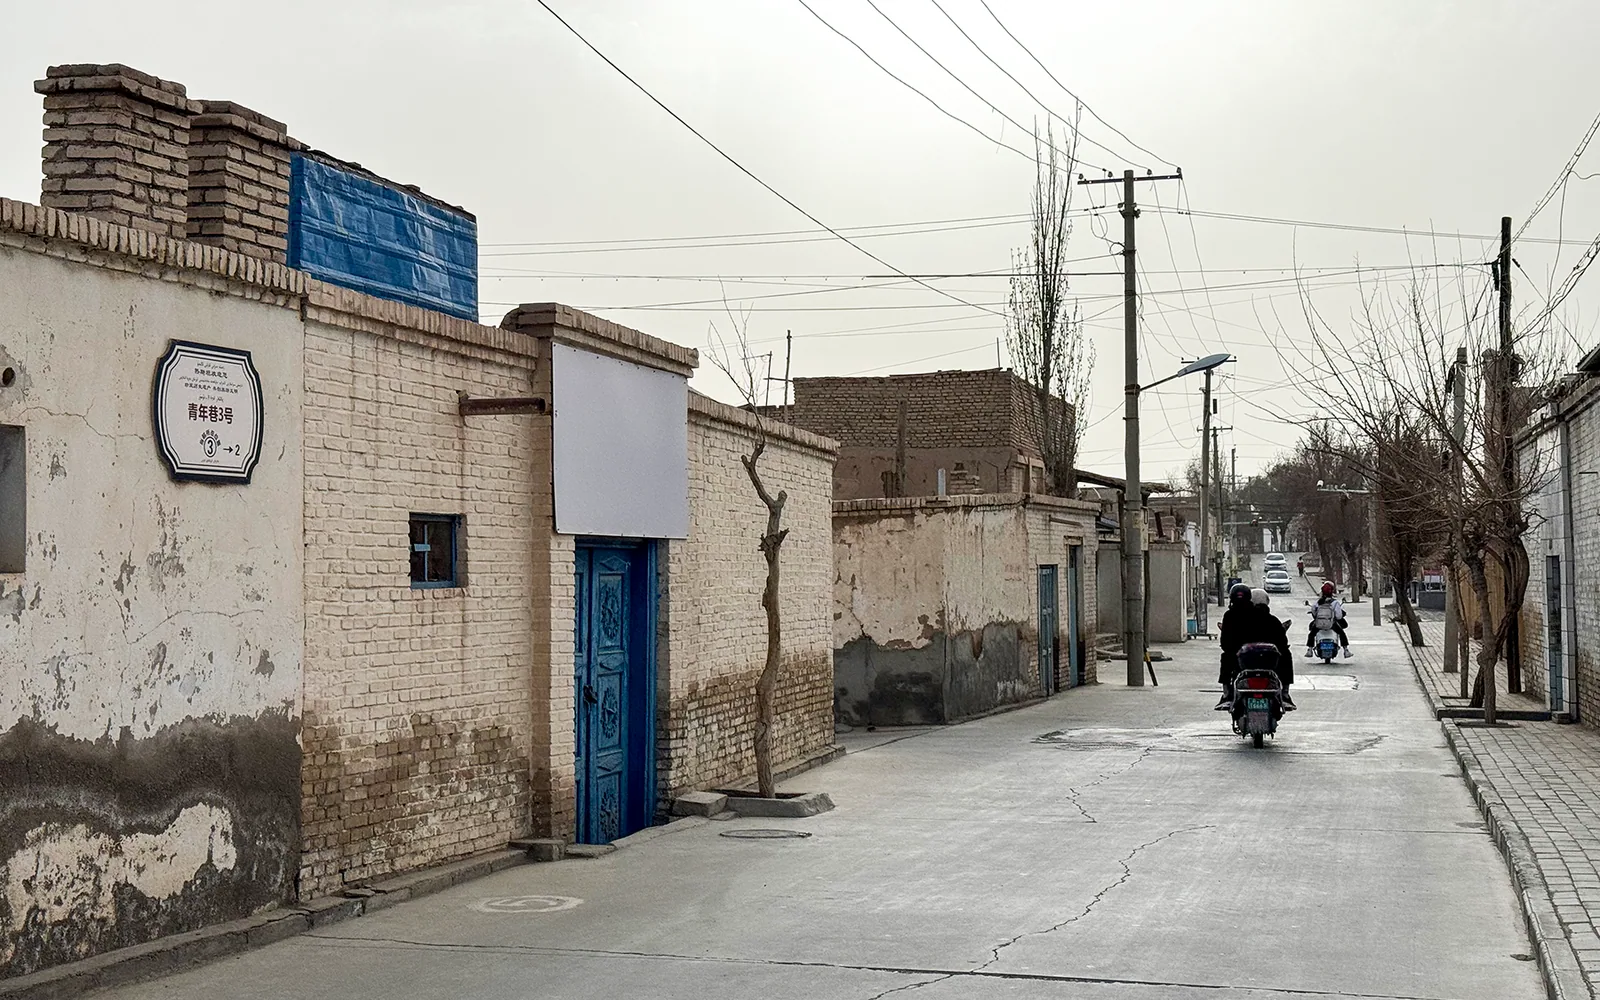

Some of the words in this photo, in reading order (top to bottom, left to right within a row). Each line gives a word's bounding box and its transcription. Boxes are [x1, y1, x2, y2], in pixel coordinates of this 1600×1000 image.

[188, 402, 234, 424] 青年巷3号
[207, 440, 214, 455] 3
[235, 444, 240, 456] 2
